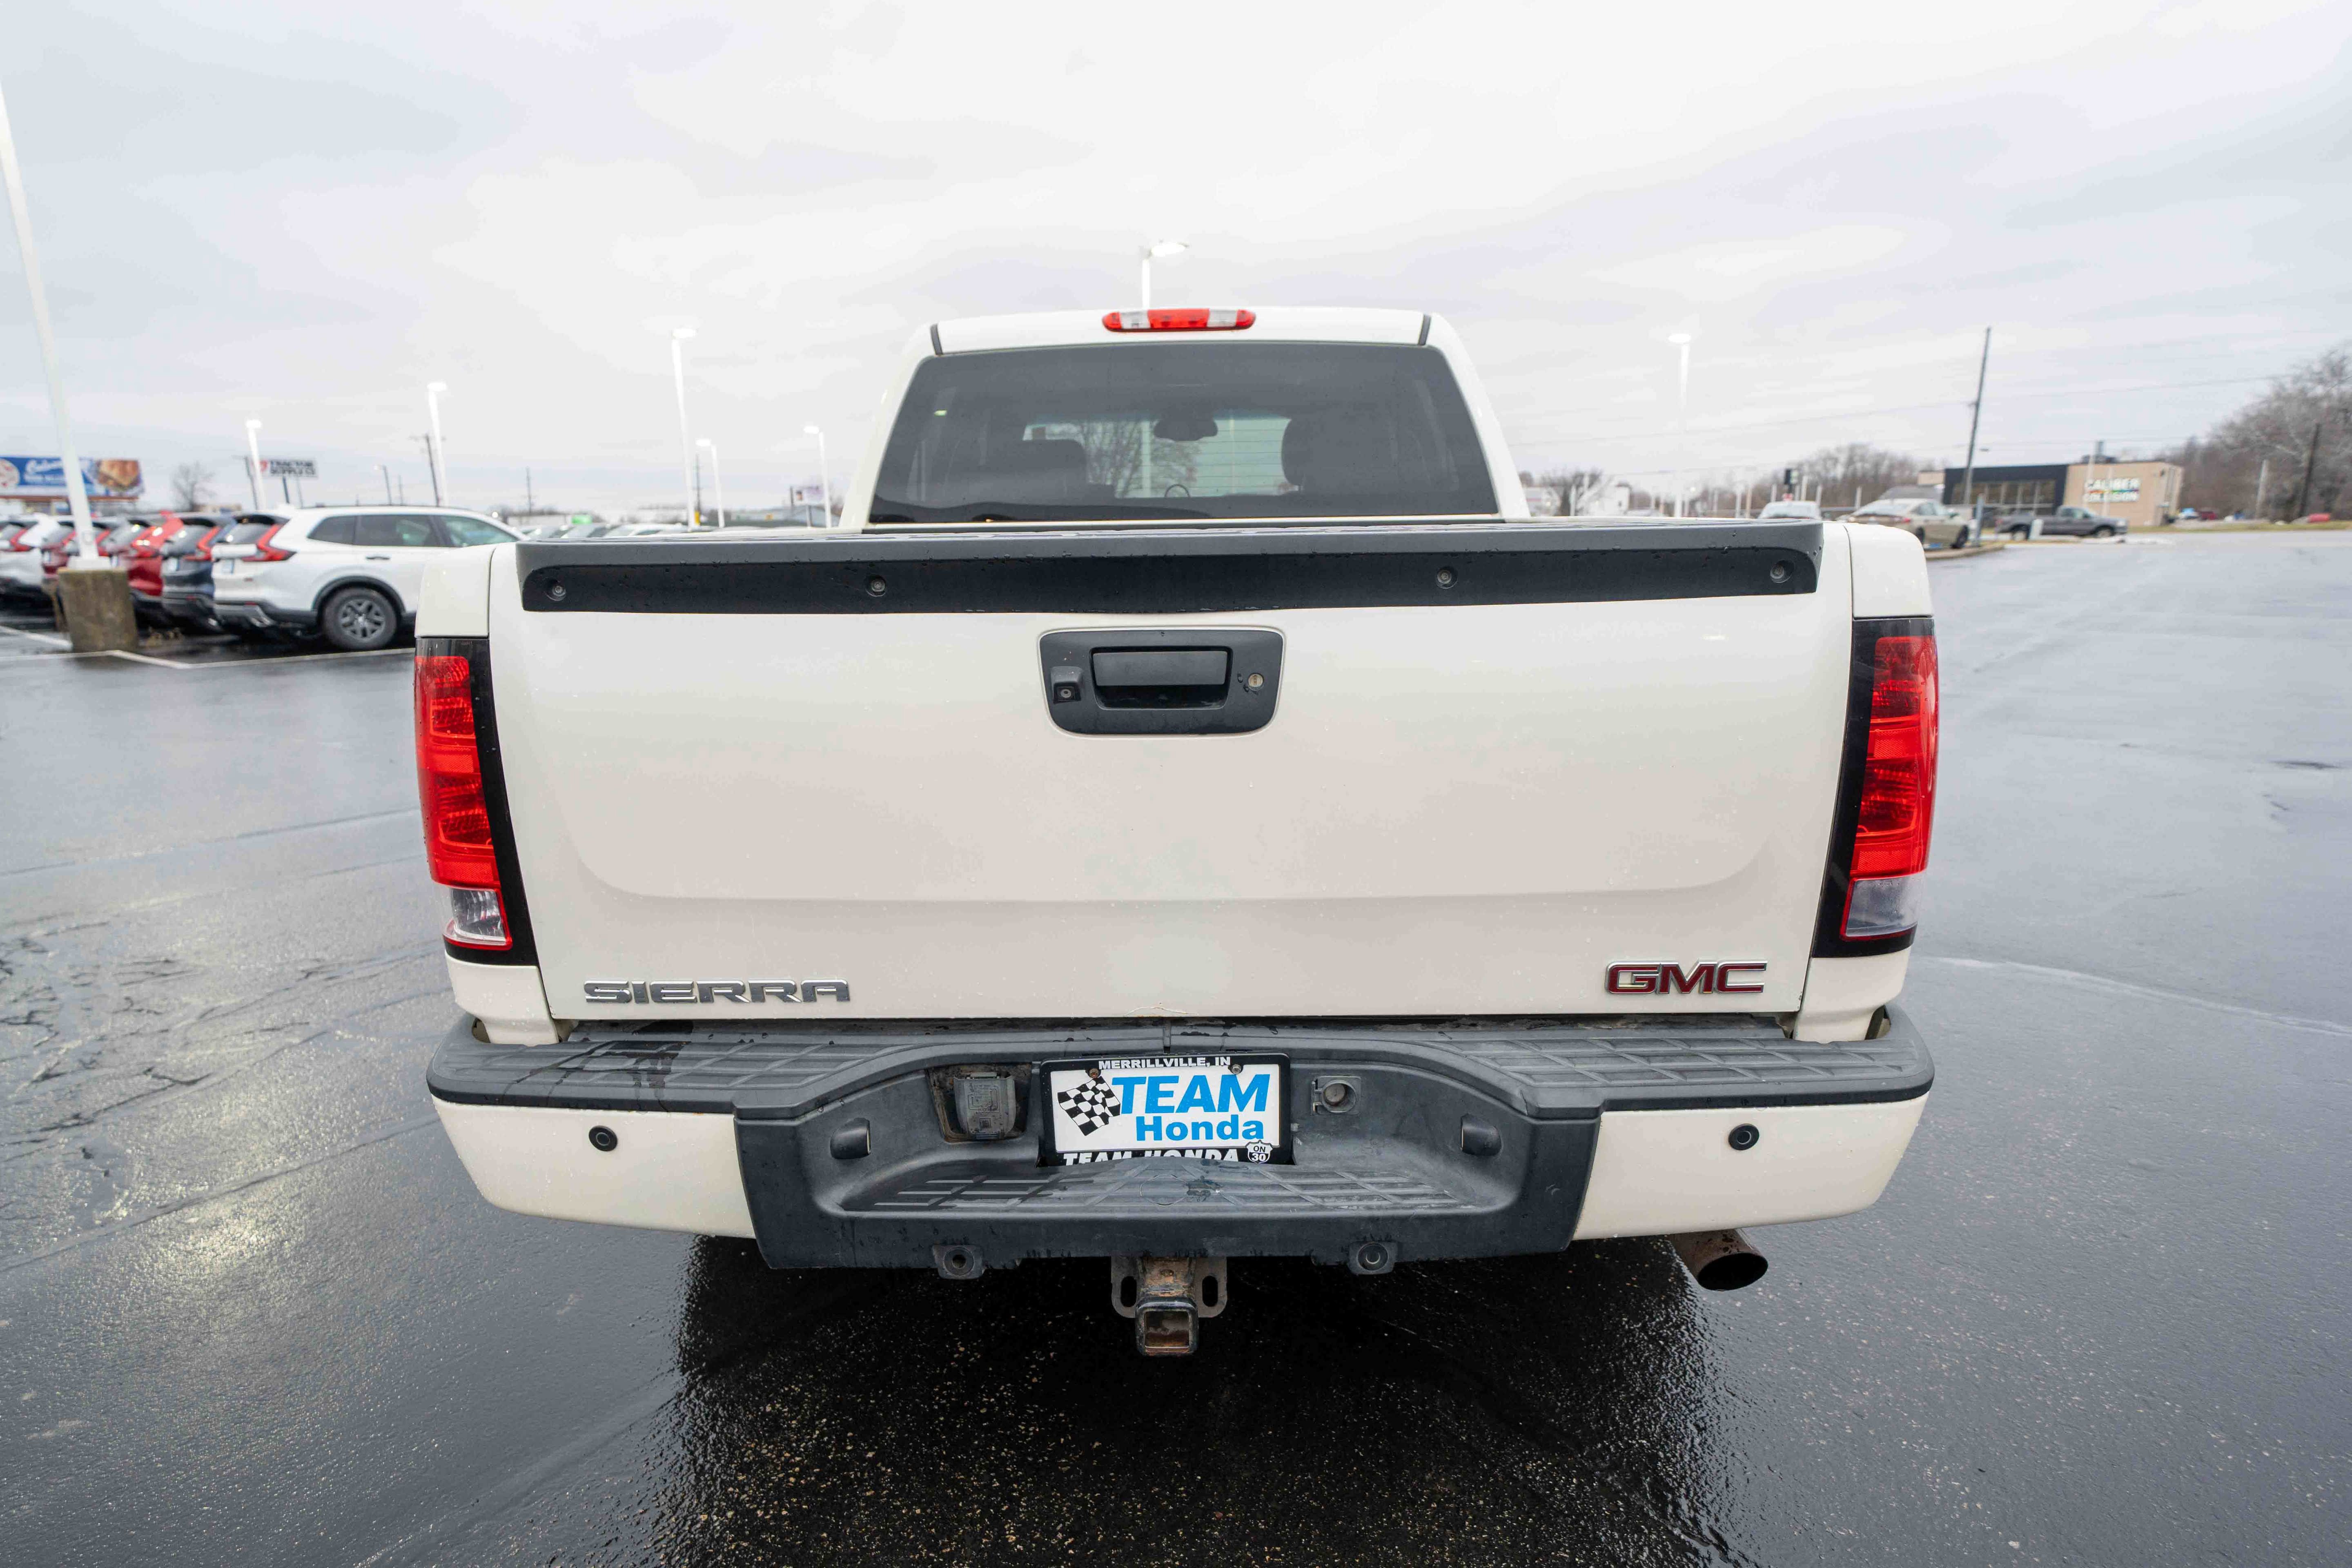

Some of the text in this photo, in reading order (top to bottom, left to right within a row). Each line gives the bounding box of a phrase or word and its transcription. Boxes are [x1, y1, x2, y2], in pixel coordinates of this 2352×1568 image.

[1605, 960, 1768, 995] GMC
[584, 979, 851, 1003] SIERRA
[1099, 1057, 1231, 1069] MERRILLVILLE, IN
[1112, 1074, 1270, 1114] TEAM
[1136, 1114, 1263, 1141] Honda
[1252, 1153, 1266, 1162] 30
